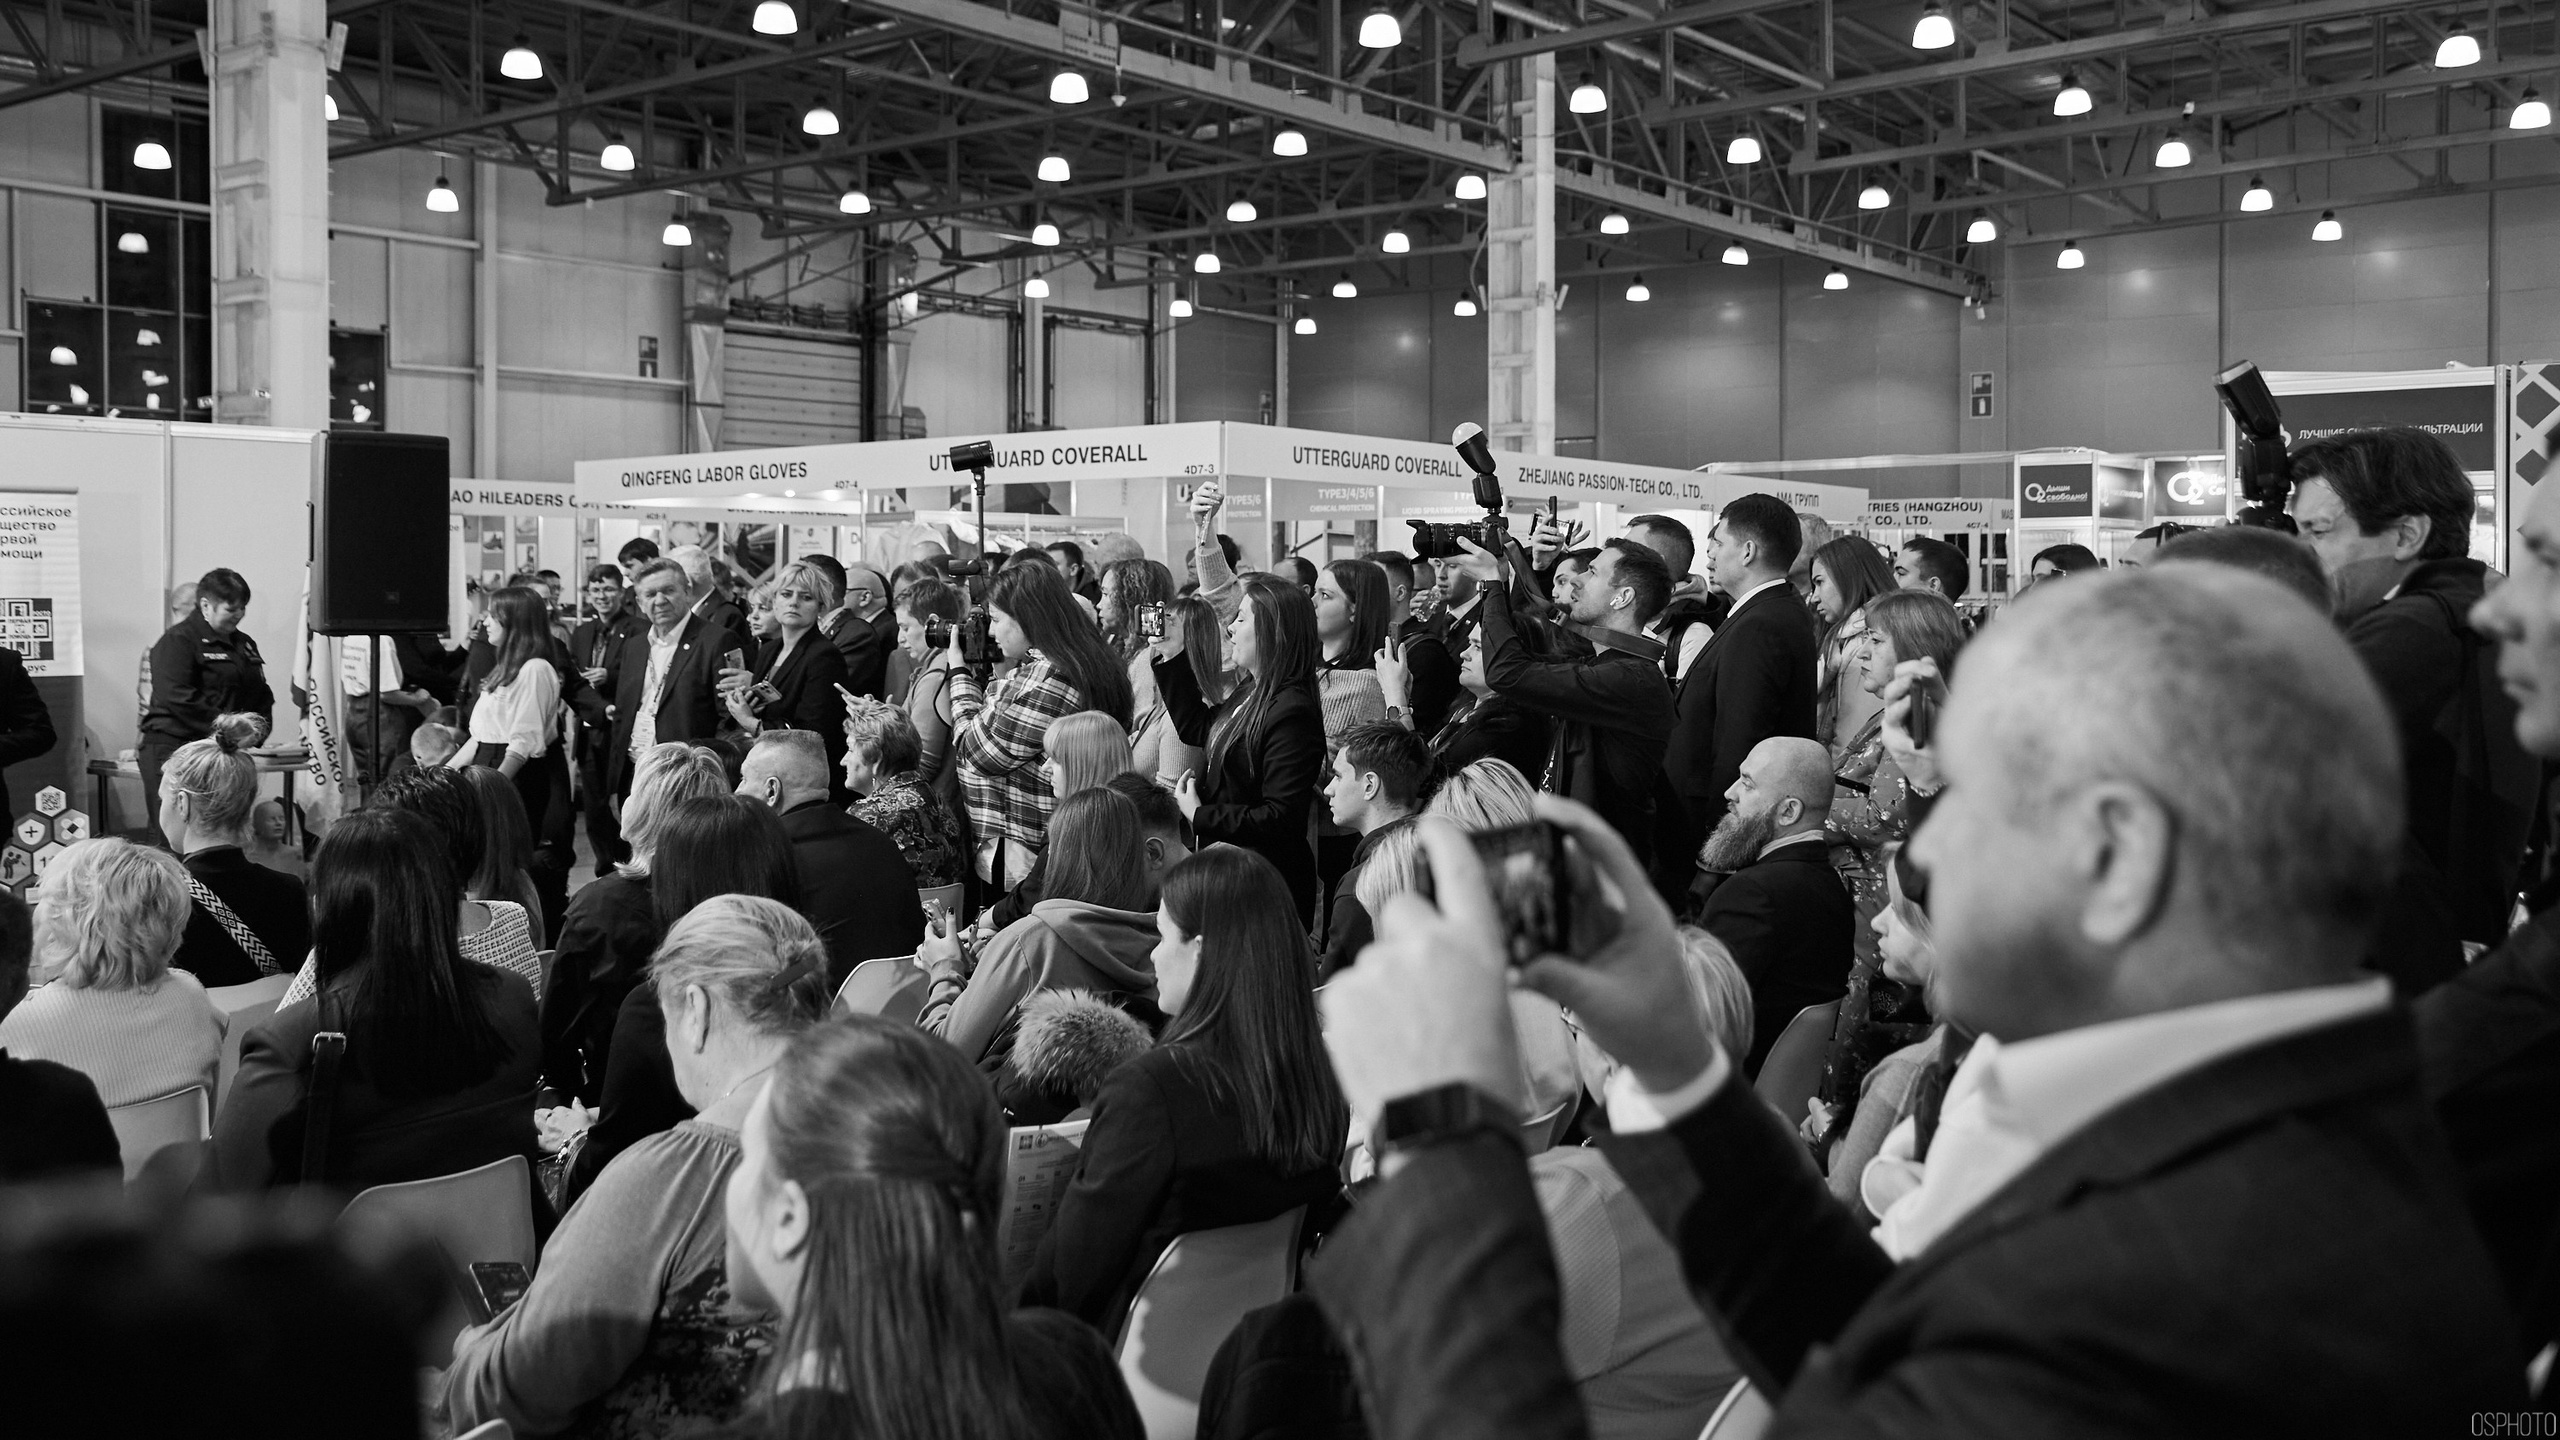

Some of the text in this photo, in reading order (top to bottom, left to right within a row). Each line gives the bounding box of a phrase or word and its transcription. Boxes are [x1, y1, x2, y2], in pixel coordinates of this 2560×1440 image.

[2298, 428, 2345, 440] ЛУЧШИЕ
[2408, 422, 2484, 435] ЛЬТРАЦИИ
[929, 443, 1148, 471] UTUARD COVERALL
[1293, 446, 1463, 478] UTTERGUARD COVERALL
[621, 461, 808, 488] QINGFENG LABOR GLOVES
[1184, 464, 1215, 475] 4D7-3
[834, 480, 858, 489] 4D7-4
[1519, 467, 1704, 499] ZHEJIANG PASSION-TECH CO., LTD.
[1317, 488, 1375, 499] TYPE3/4/5/6
[2046, 485, 2070, 493] Дыши
[452, 490, 474, 503] AO
[480, 491, 564, 507] HILEADERS
[1227, 494, 1262, 505] TYPE5/6
[1795, 493, 1820, 507] ГРУПП
[1309, 504, 1375, 513] CHEMICAL PROTECTION
[1401, 507, 1422, 515] LIQUID
[1423, 506, 1454, 515] SPRAYING
[1904, 502, 1983, 514] (HANGZHOU)
[1227, 510, 1262, 518] PROTECTION
[1875, 516, 1901, 526] CO.,
[1906, 516, 1932, 525] LTD.
[0, 550, 43, 559] мощи
